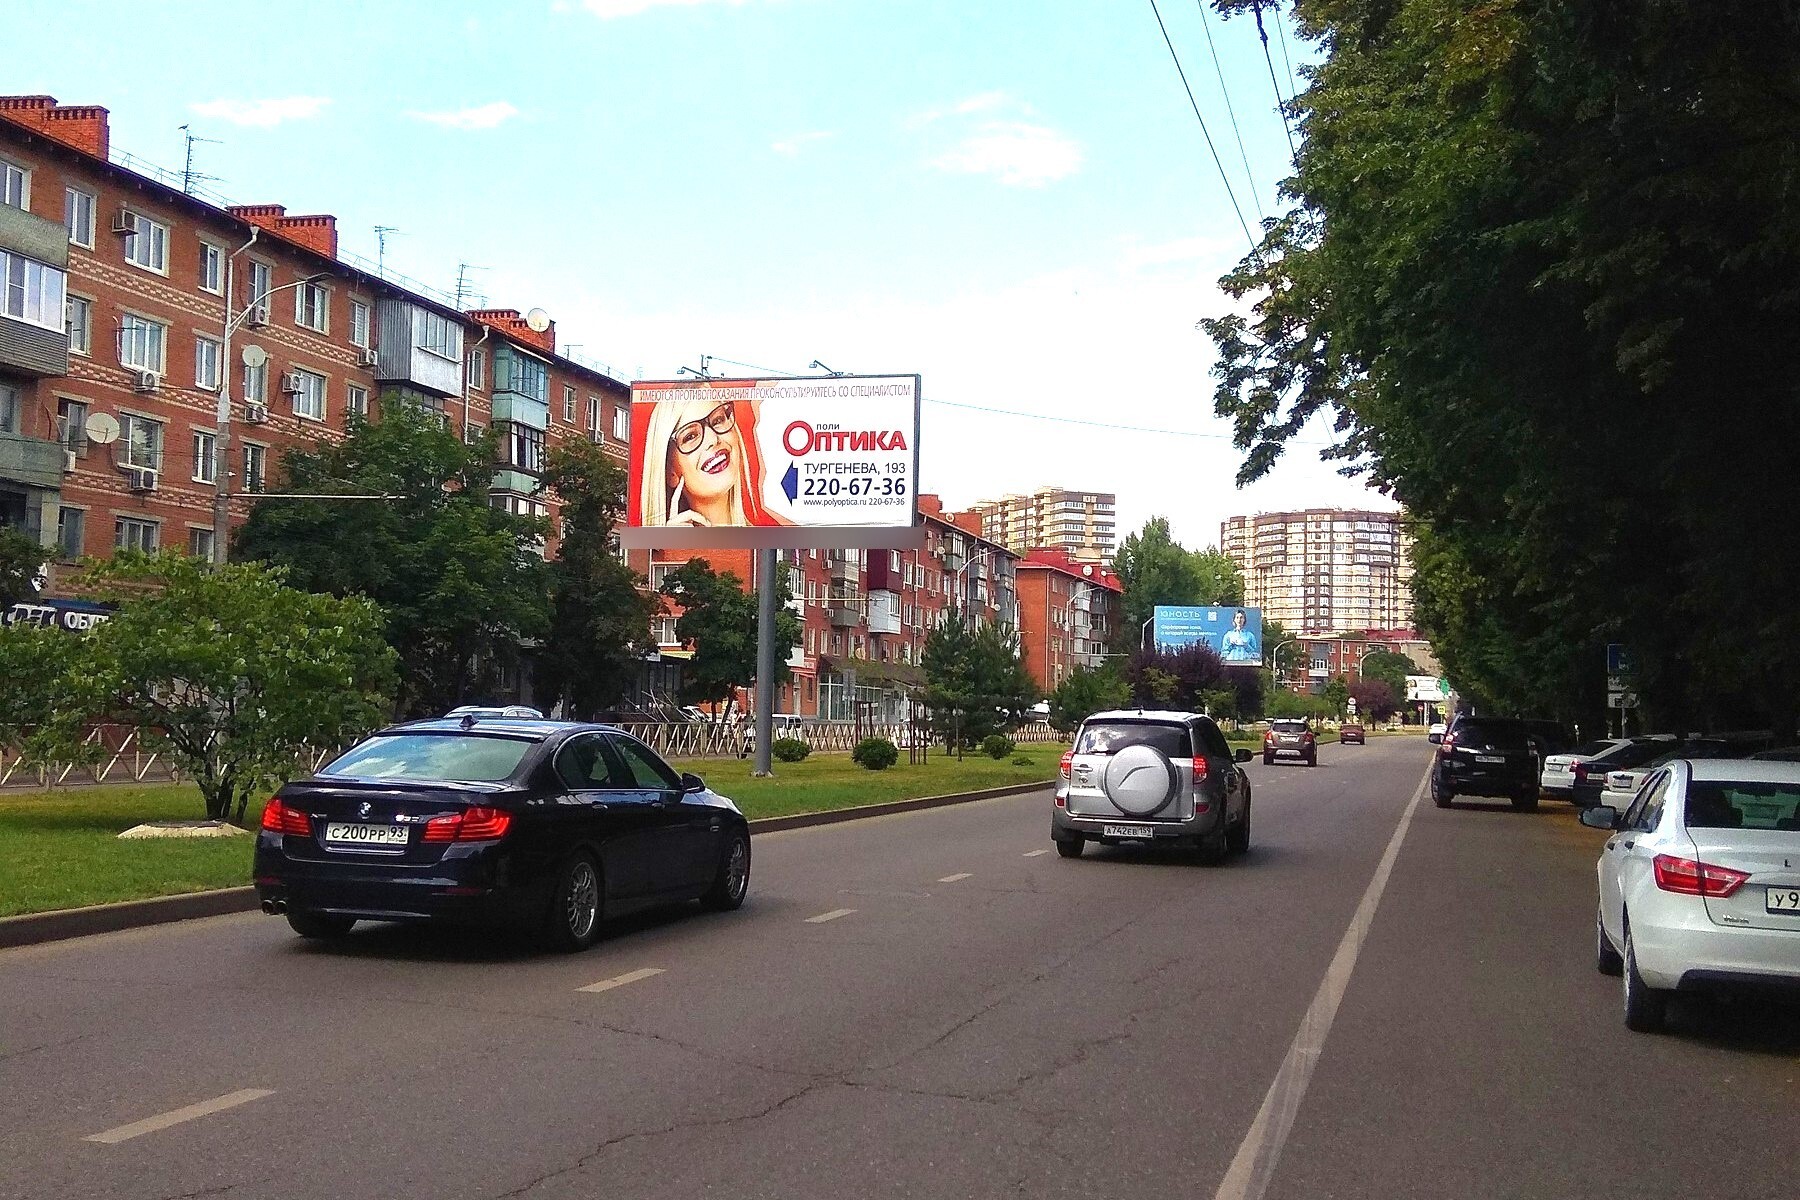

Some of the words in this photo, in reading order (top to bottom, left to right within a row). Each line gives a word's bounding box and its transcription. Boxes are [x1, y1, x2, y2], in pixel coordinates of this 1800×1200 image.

[640, 390, 674, 401] ИМЕЮТСЯ
[838, 385, 848, 397] СО
[850, 385, 911, 397] СПЕЦИАЛИСТОМ
[782, 420, 908, 457] ОПТИКА
[803, 462, 881, 475] ТУРГЕНЕВА,
[884, 462, 906, 474] 193
[803, 478, 906, 496] 220-67-36
[803, 498, 867, 507] www.polyoptica.ru
[868, 498, 905, 506] 220-67-36
[332, 826, 386, 840] С200РР
[390, 826, 404, 838] 93
